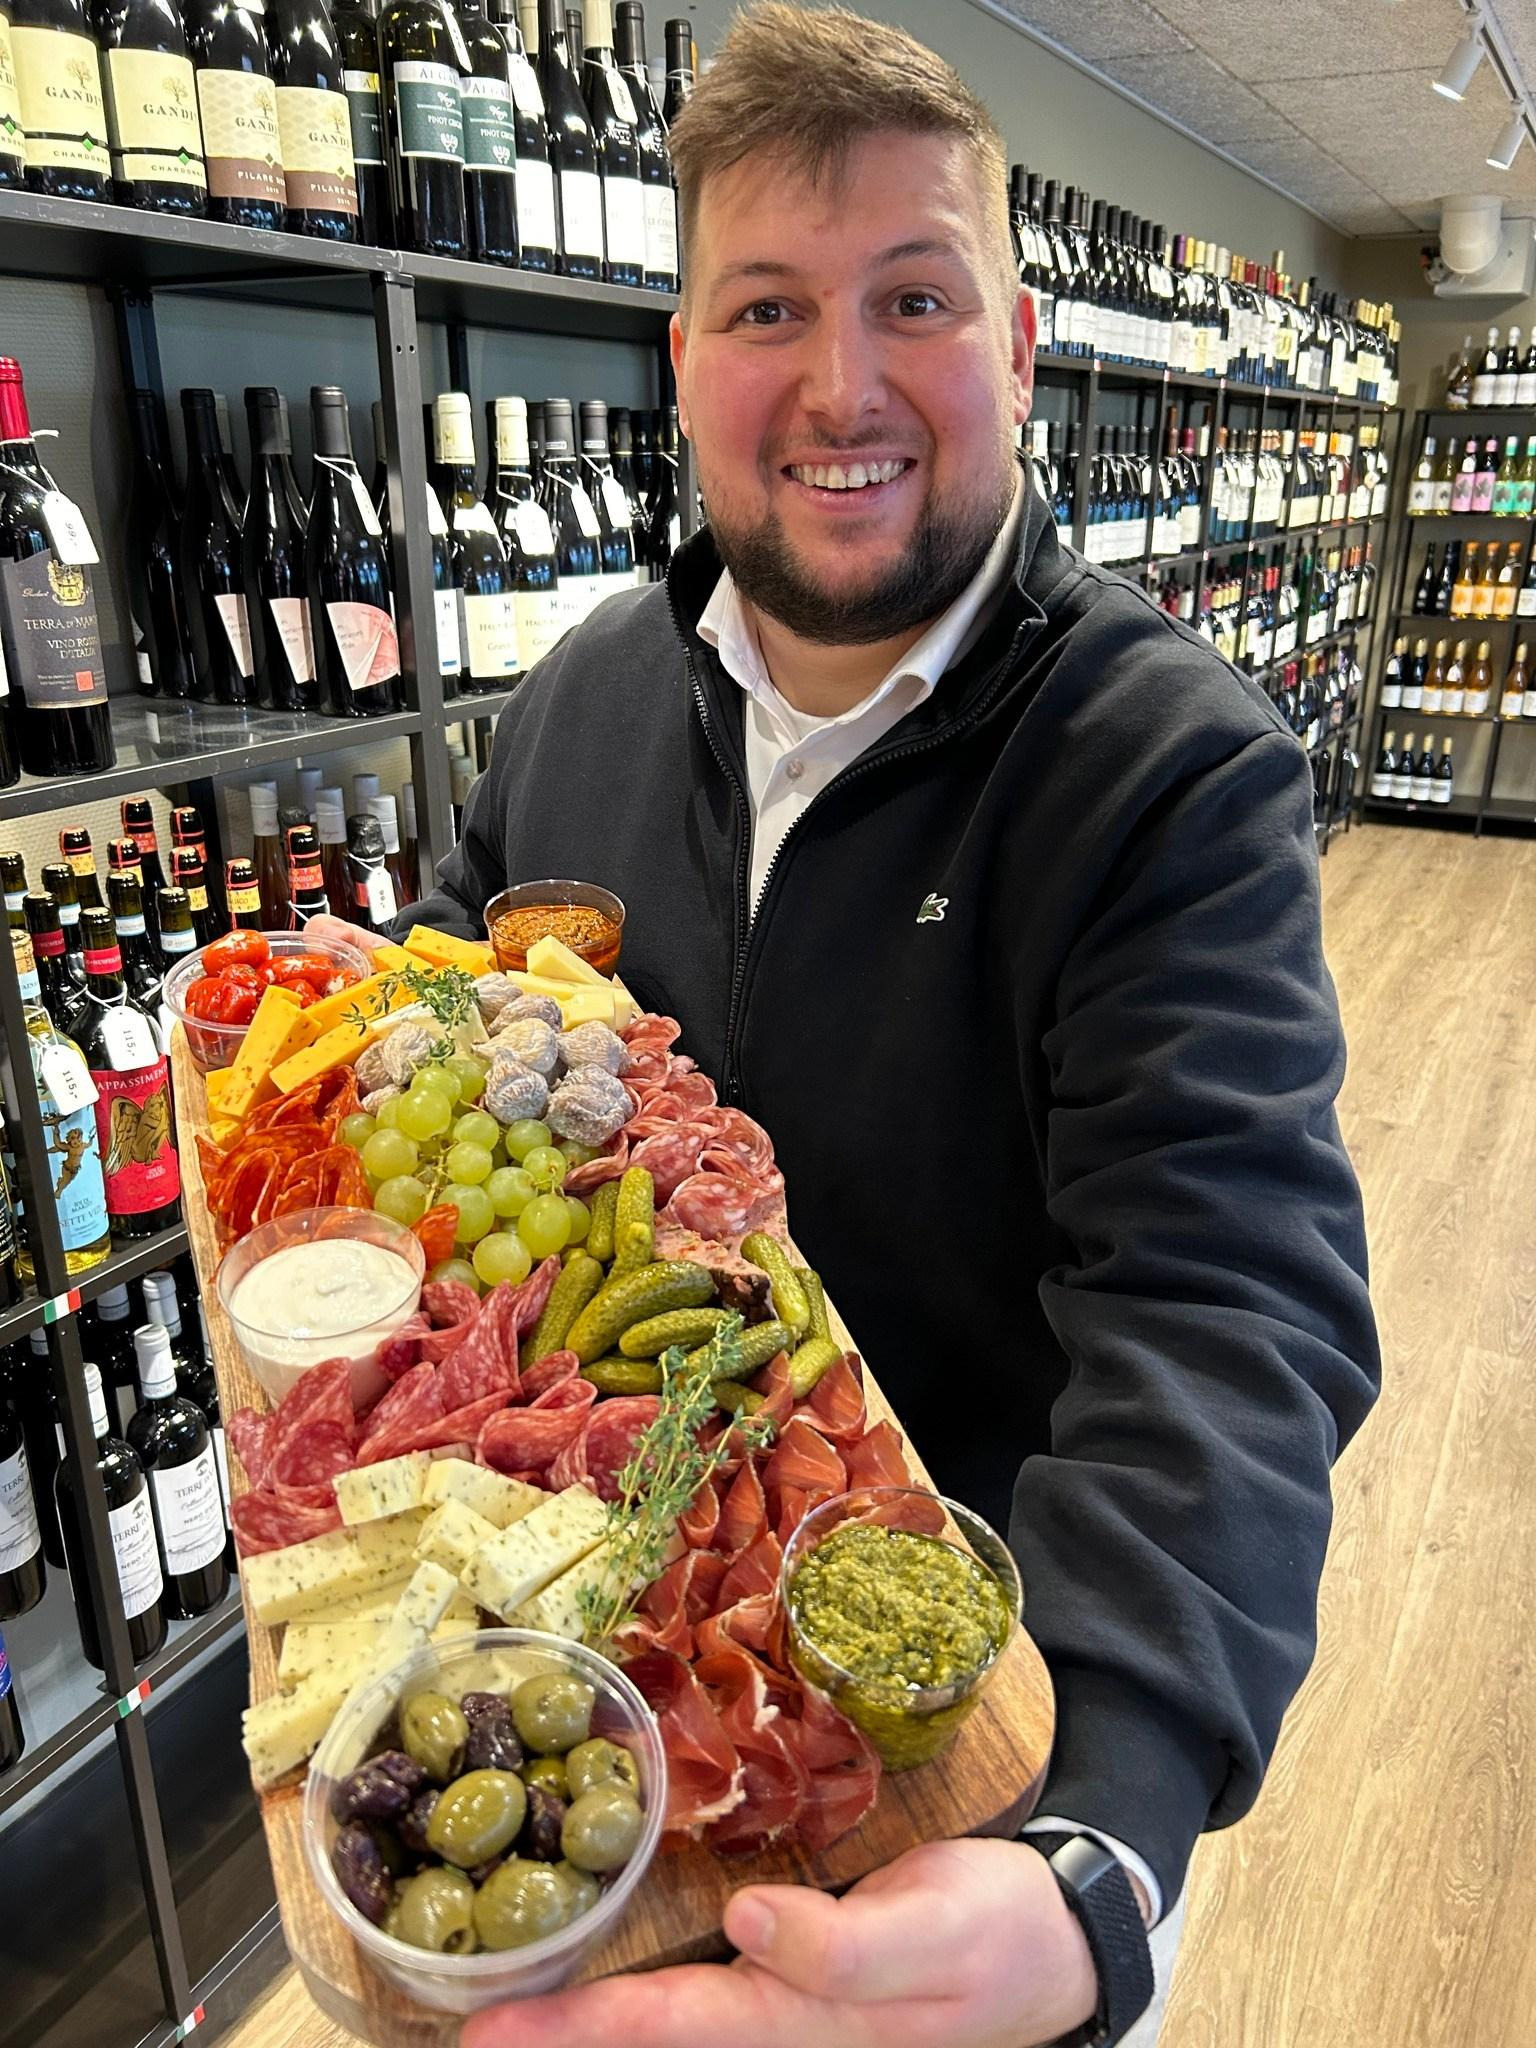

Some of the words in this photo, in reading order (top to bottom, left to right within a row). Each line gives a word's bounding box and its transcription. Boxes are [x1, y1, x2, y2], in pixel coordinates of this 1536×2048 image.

[24, 618, 65, 631] TERRA
[47, 639, 75, 649] VINO
[123, 1030, 136, 1056] 115,-
[63, 1070, 78, 1098] 115,-
